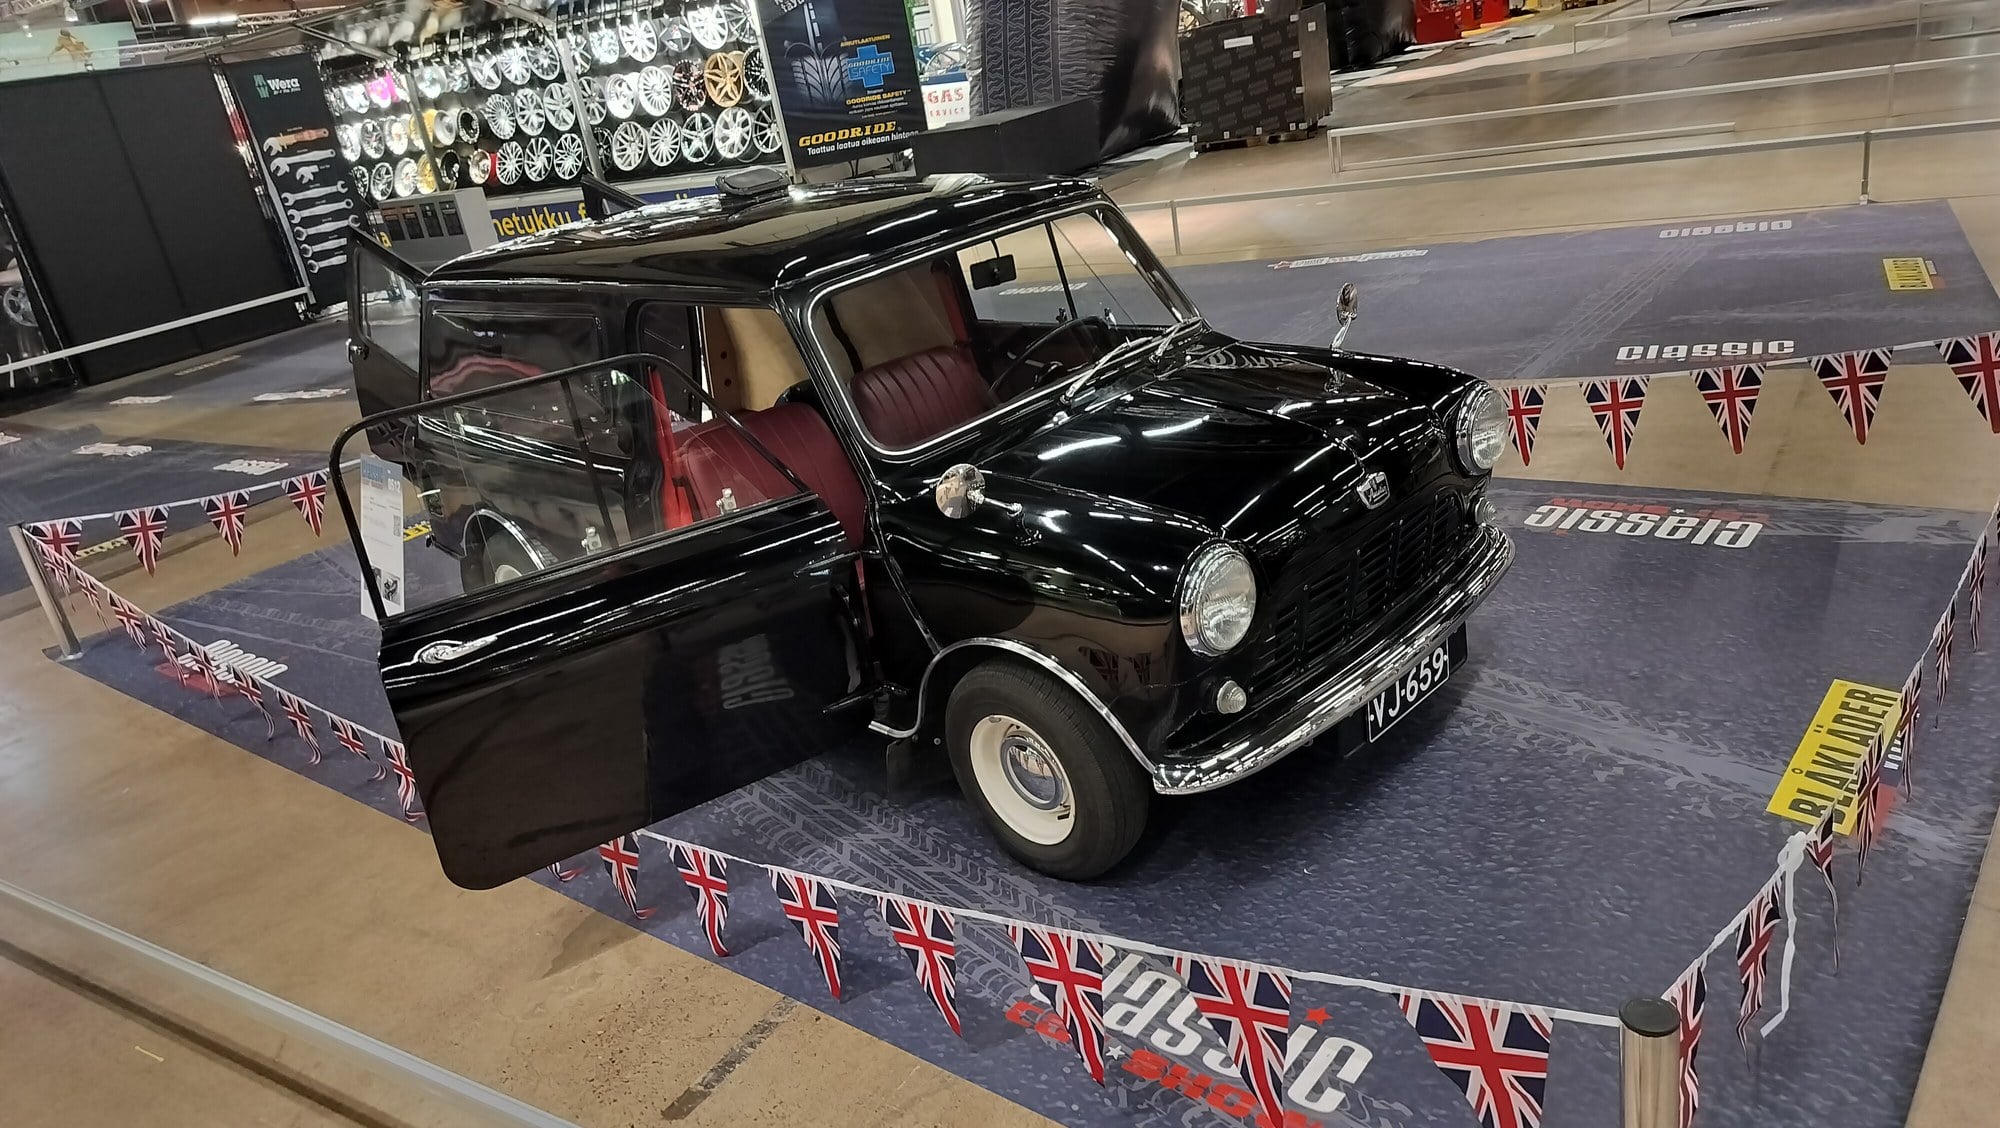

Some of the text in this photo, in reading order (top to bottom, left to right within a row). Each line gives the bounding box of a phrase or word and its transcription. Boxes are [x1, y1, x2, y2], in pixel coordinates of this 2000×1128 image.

[851, 62, 890, 78] SAFETY
[266, 78, 300, 91] Wera
[798, 120, 898, 147] GOODRIDE
[807, 143, 836, 156] Taattua
[836, 139, 860, 151] laatua
[861, 135, 891, 147] oikeaan
